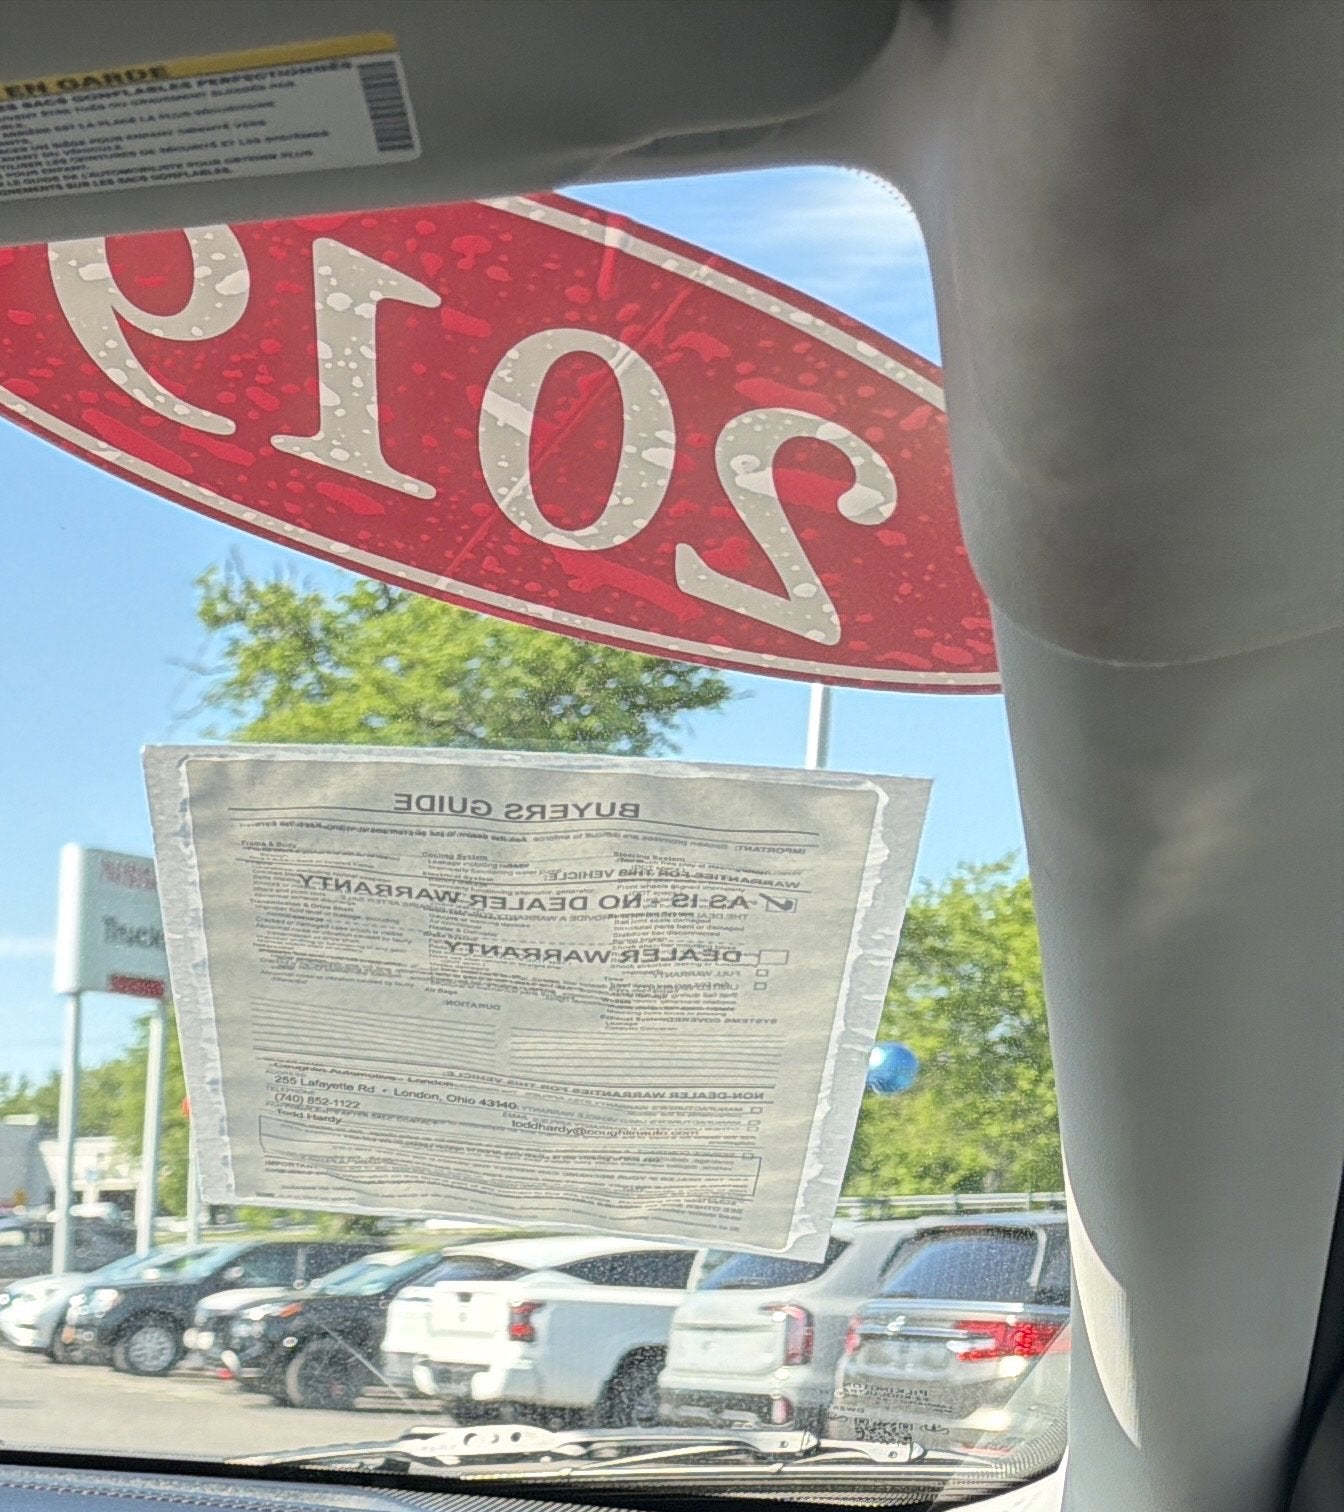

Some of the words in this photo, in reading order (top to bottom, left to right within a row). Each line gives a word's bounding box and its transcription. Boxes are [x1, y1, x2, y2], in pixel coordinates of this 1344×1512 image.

[4, 80, 46, 98] EN
[275, 1075, 297, 1086] 255
[300, 1077, 354, 1093] Lafayette
[358, 1084, 375, 1094] Rd
[394, 1087, 443, 1102] London,
[446, 1093, 475, 1105] Ohio
[274, 1092, 305, 1105] (740)
[307, 1095, 361, 1109] 852-1122
[276, 1108, 303, 1119] Todd
[306, 1111, 343, 1126] Hardy
